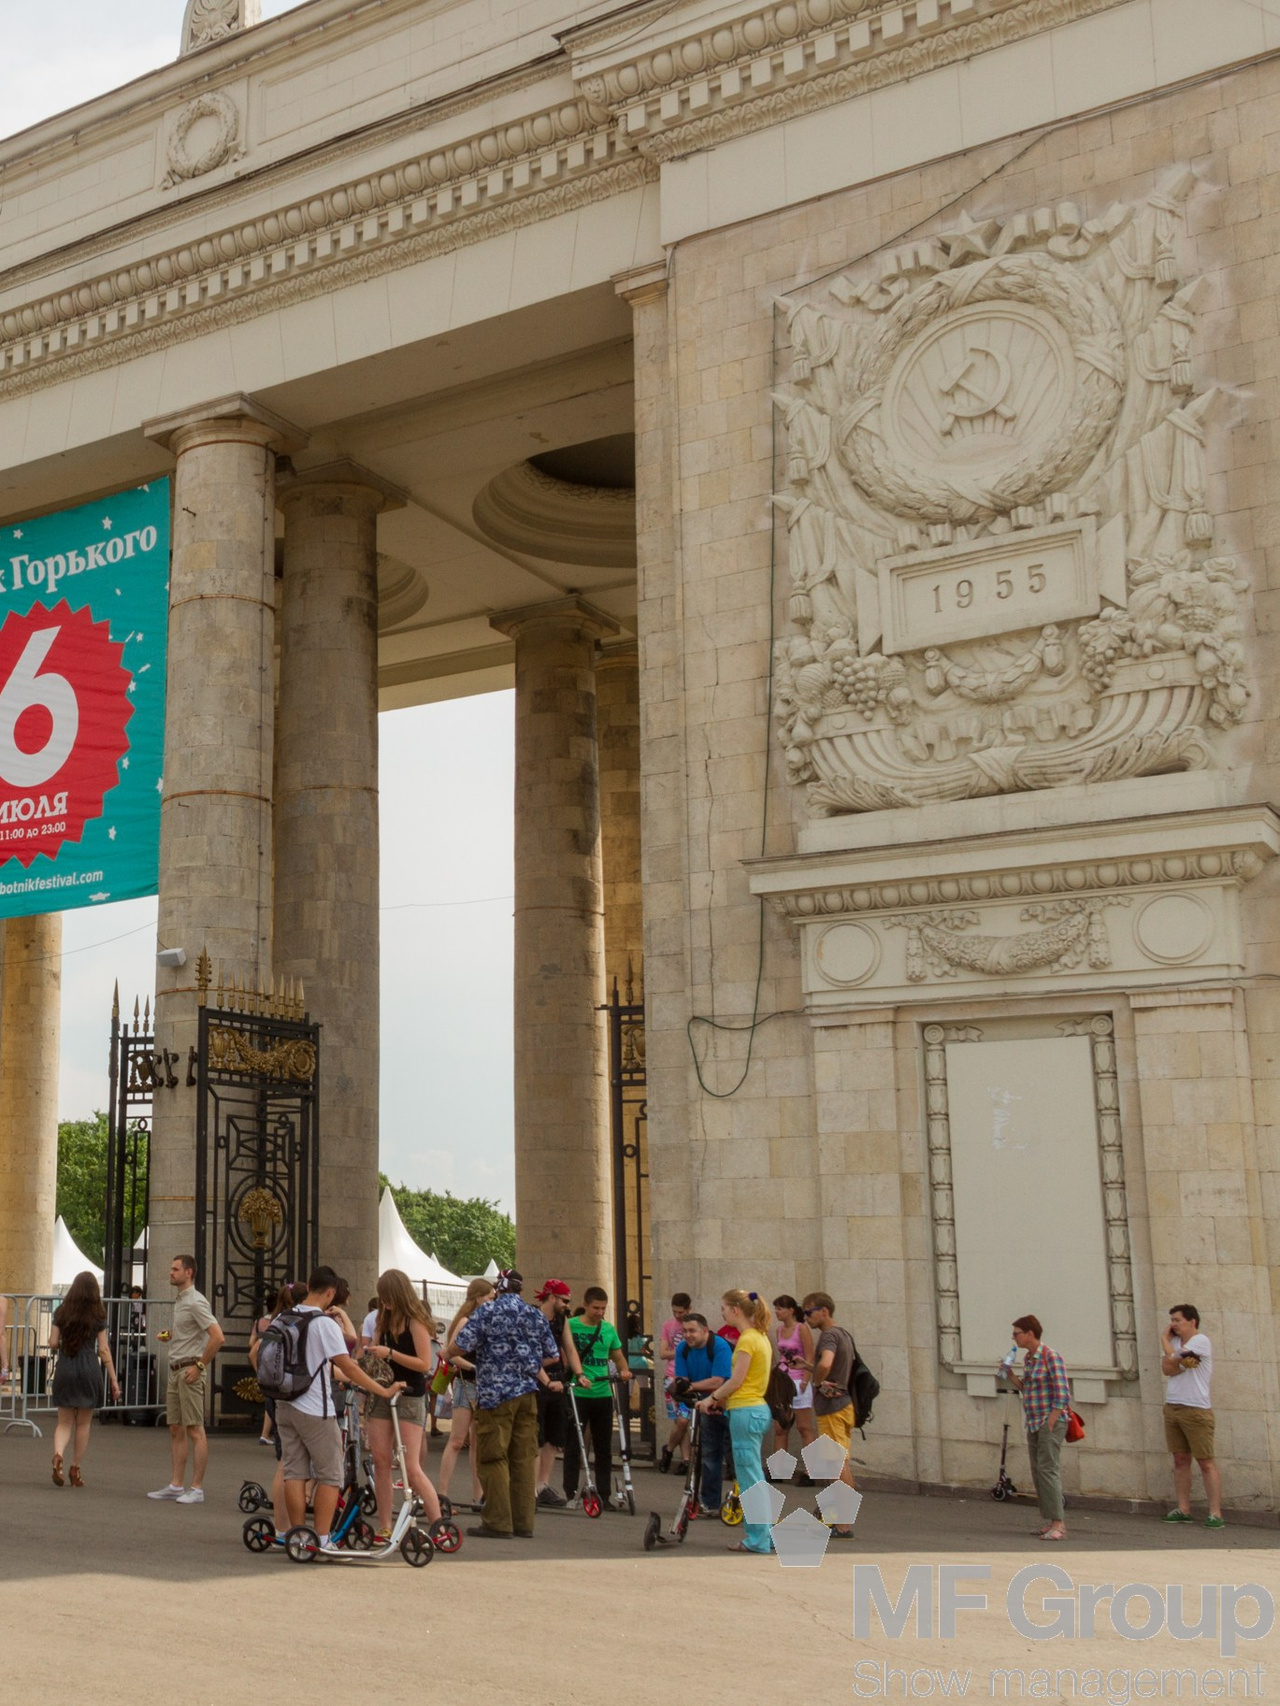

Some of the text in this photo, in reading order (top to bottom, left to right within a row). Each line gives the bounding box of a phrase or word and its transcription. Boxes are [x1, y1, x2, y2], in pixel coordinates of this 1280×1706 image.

[10, 525, 158, 594] Горького
[932, 563, 1047, 614] 1955
[0, 828, 24, 841] 11:00
[41, 821, 66, 835] 23:00
